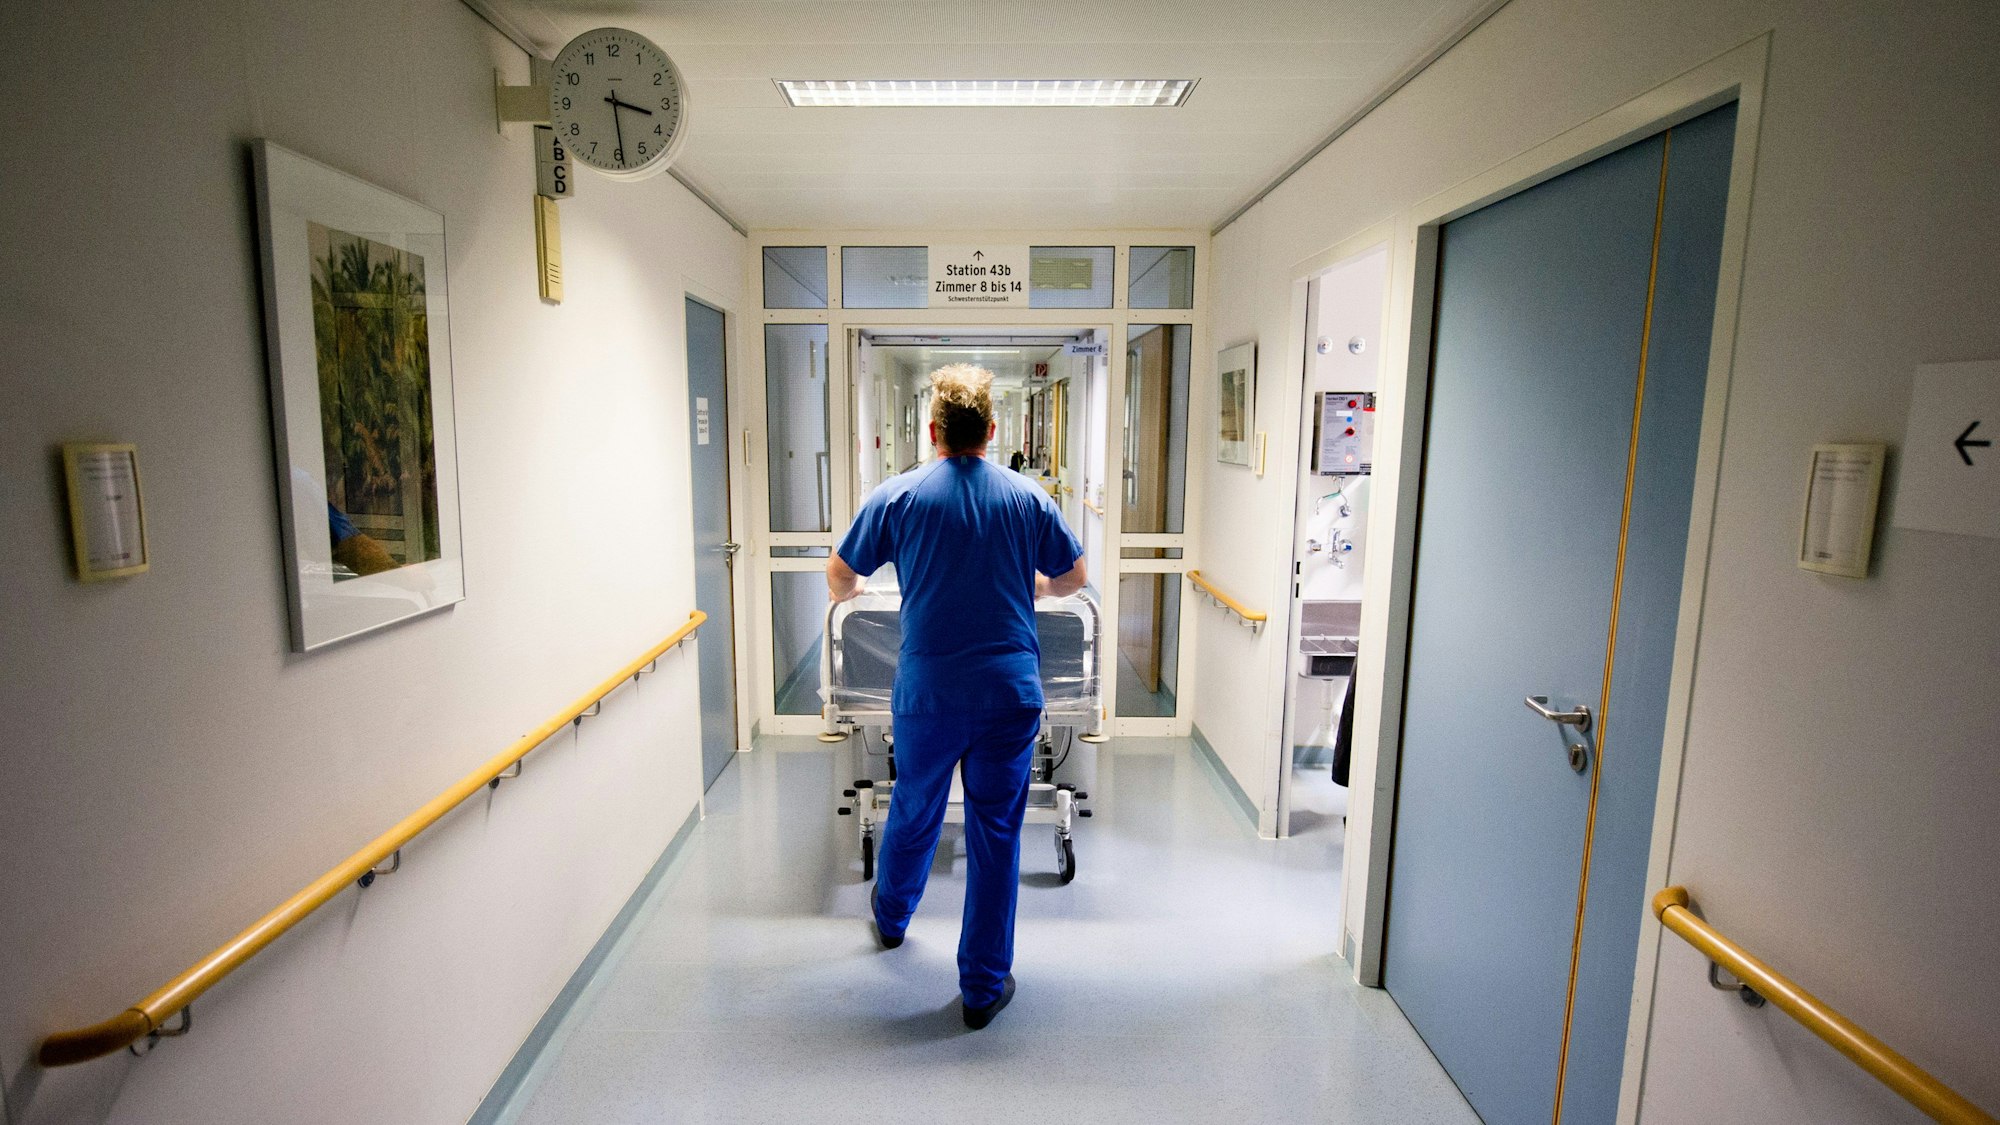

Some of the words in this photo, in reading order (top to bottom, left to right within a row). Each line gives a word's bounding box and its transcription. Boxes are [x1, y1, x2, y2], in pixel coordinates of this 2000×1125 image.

[606, 44, 620, 57] 12
[584, 53, 594, 65] 11
[635, 53, 641, 65] 1
[565, 73, 580, 85] 10
[653, 73, 662, 85] 2
[562, 97, 571, 110] 9
[661, 98, 670, 110] 3
[570, 123, 579, 136] 8
[653, 124, 662, 136] 4
[553, 147, 565, 161] B
[590, 142, 598, 154] 7
[637, 142, 647, 154] 5
[613, 148, 622, 161] 6
[554, 166, 566, 180] C
[555, 180, 566, 193] D
[946, 264, 986, 276] Station
[990, 264, 1011, 276] 43b
[936, 281, 977, 292] Zimmer
[980, 281, 987, 292] 8
[991, 281, 1007, 292] bis
[1010, 281, 1022, 292] 14
[1072, 345, 1097, 353] Zimmer
